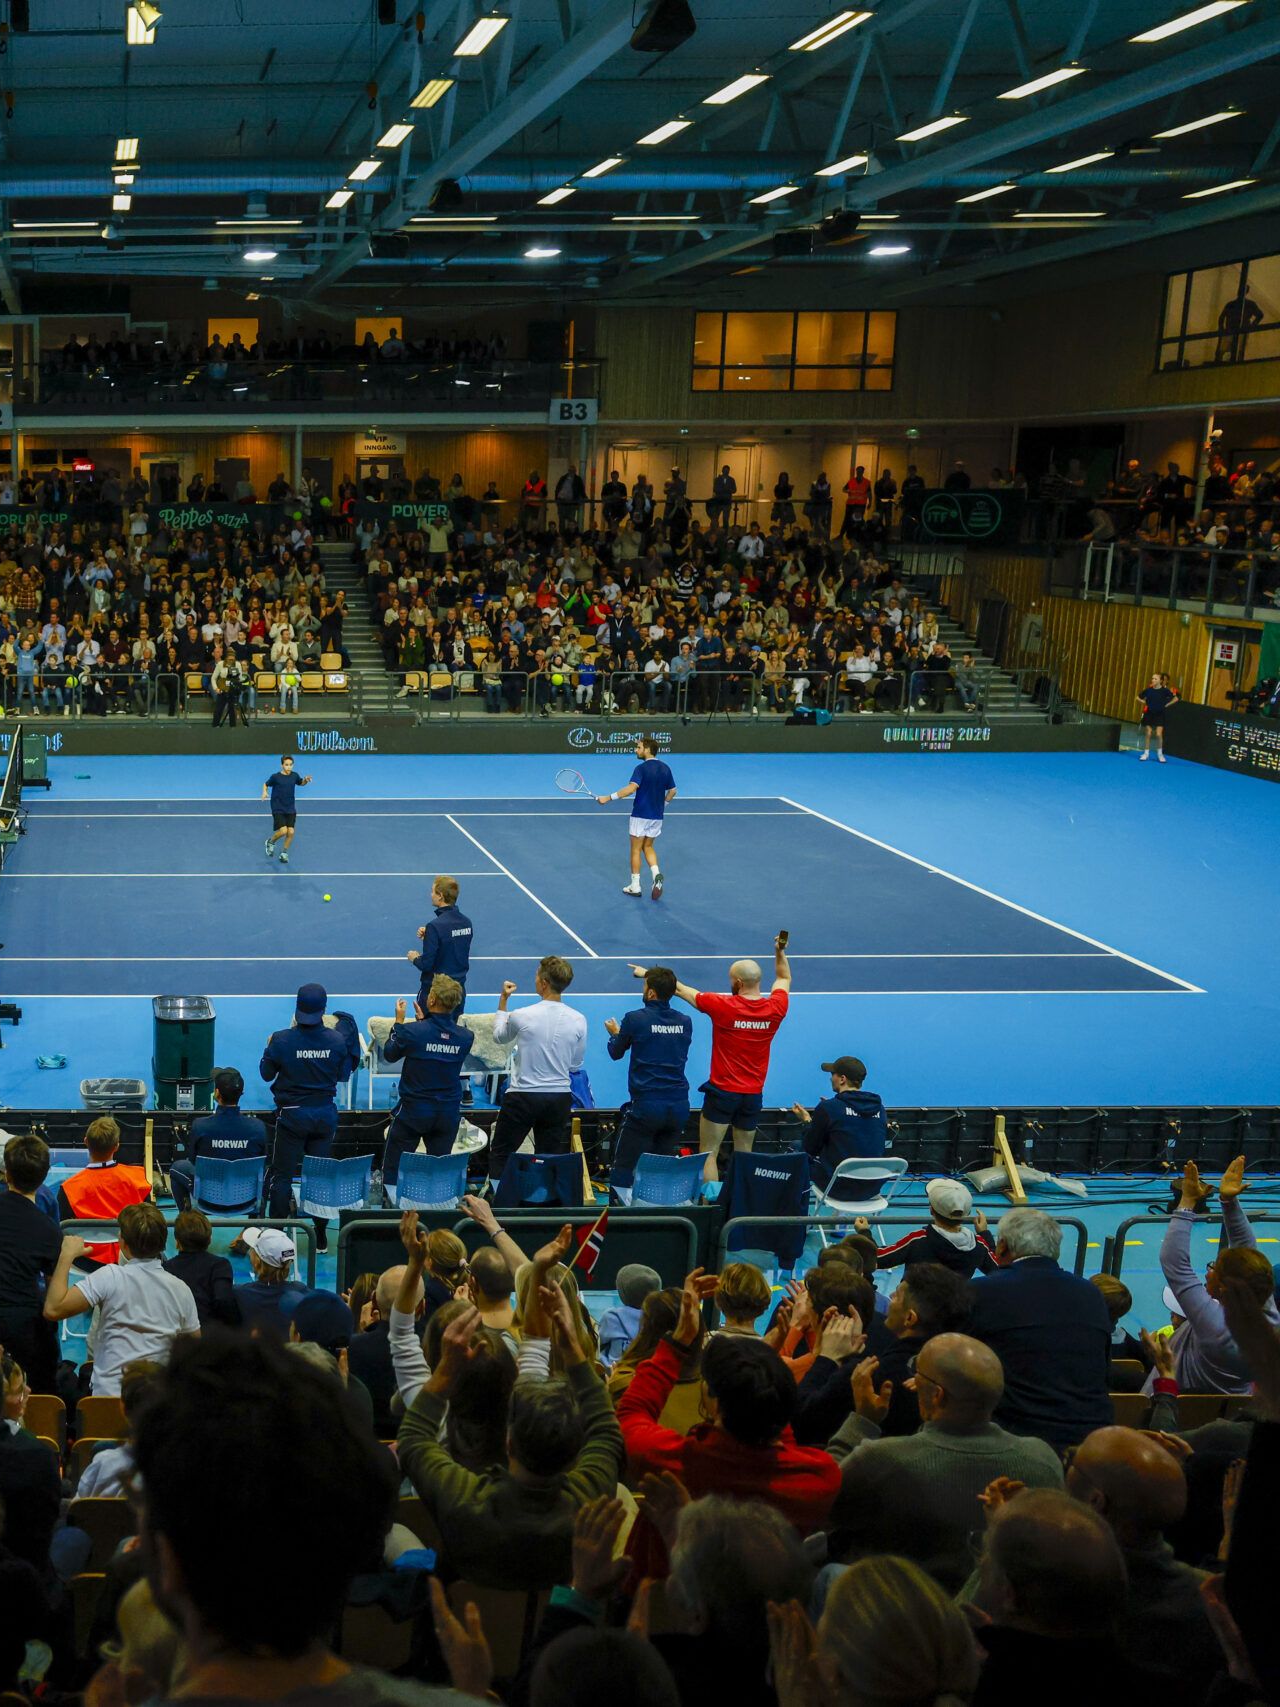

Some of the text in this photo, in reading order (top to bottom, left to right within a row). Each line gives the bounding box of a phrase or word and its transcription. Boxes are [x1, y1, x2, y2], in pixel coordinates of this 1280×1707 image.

[559, 403, 588, 420] B3
[391, 504, 448, 518] POWER
[883, 727, 991, 742] QUALIFIERS 2026
[1215, 719, 1241, 741] THE
[1227, 744, 1248, 762] OF
[651, 1024, 685, 1034] NORWAY
[733, 1020, 771, 1030] NORWAY
[296, 1049, 331, 1059] NORWAY
[426, 1043, 461, 1055] NORWAY
[211, 1139, 249, 1149] NORWAY
[755, 1167, 792, 1181] NORWAY
